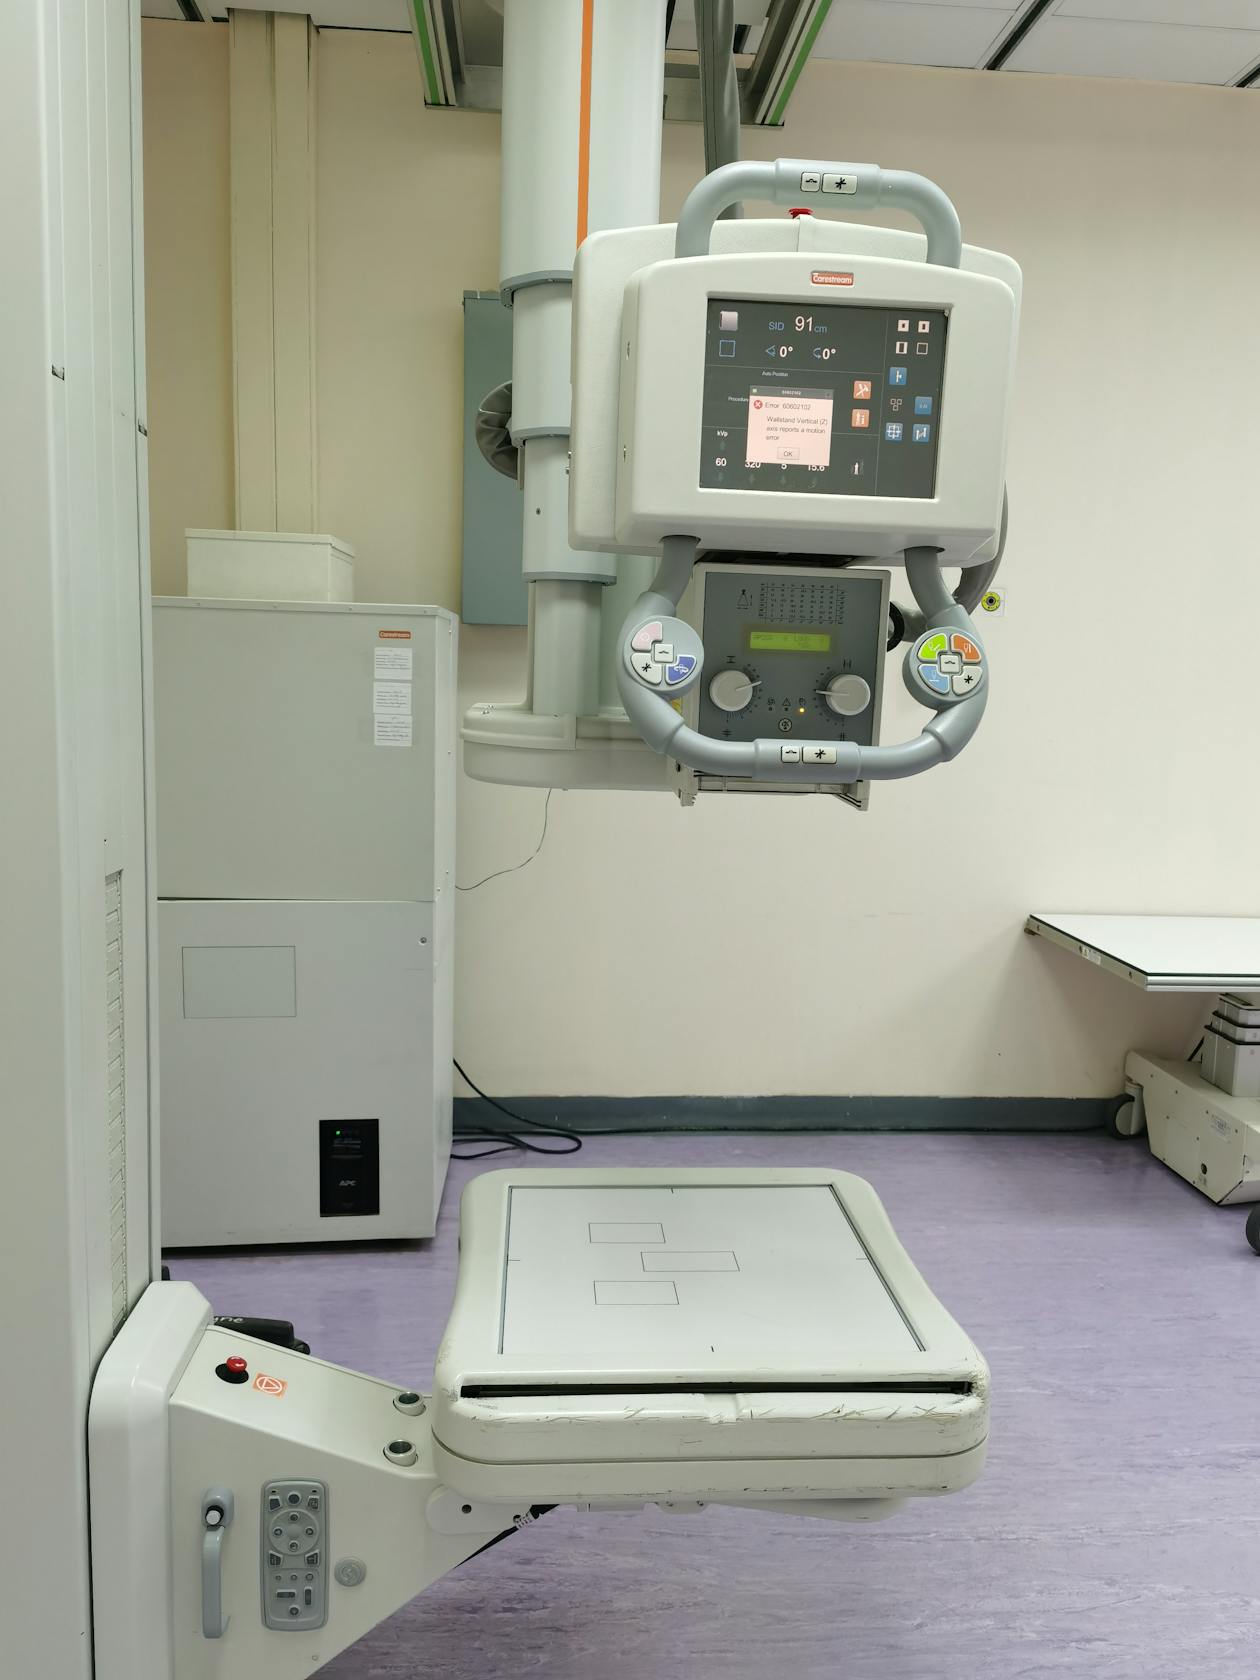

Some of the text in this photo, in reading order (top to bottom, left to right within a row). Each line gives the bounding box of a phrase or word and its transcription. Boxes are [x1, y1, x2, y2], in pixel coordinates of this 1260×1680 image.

[768, 315, 828, 333] SID 91 cm
[767, 416, 828, 426] Wallstand Vertical (Z)
[715, 458, 727, 467] 60
